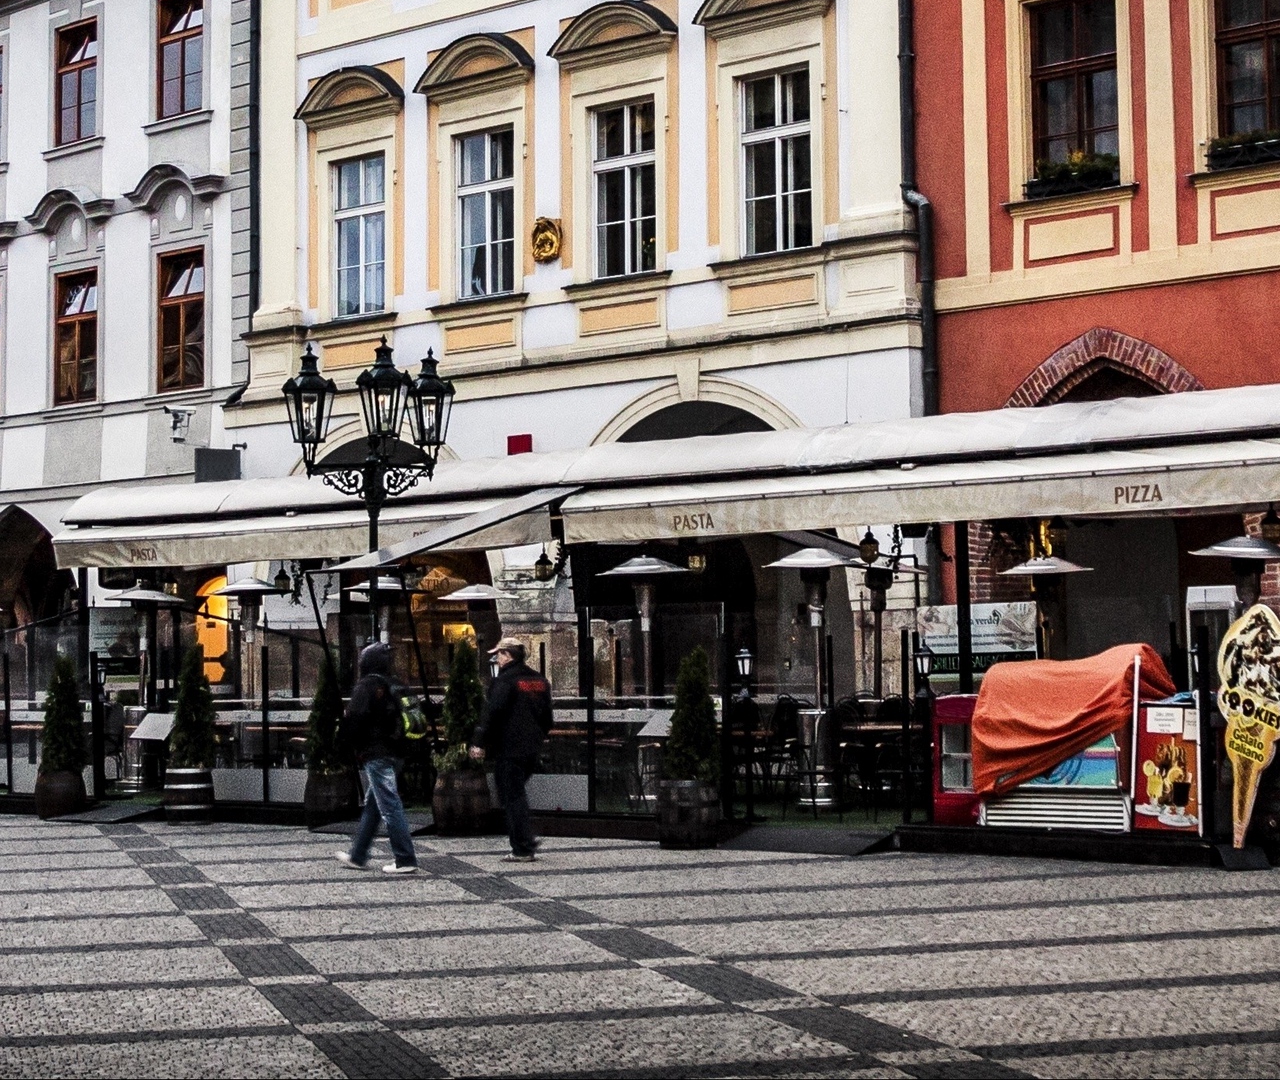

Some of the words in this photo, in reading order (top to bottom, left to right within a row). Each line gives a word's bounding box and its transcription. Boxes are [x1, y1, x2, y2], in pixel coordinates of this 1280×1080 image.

[1114, 483, 1163, 504] PIZZA
[672, 512, 715, 531] PASTA
[130, 548, 158, 563] PASTA
[1233, 728, 1265, 751] Gelato
[1228, 740, 1265, 763] italiano
